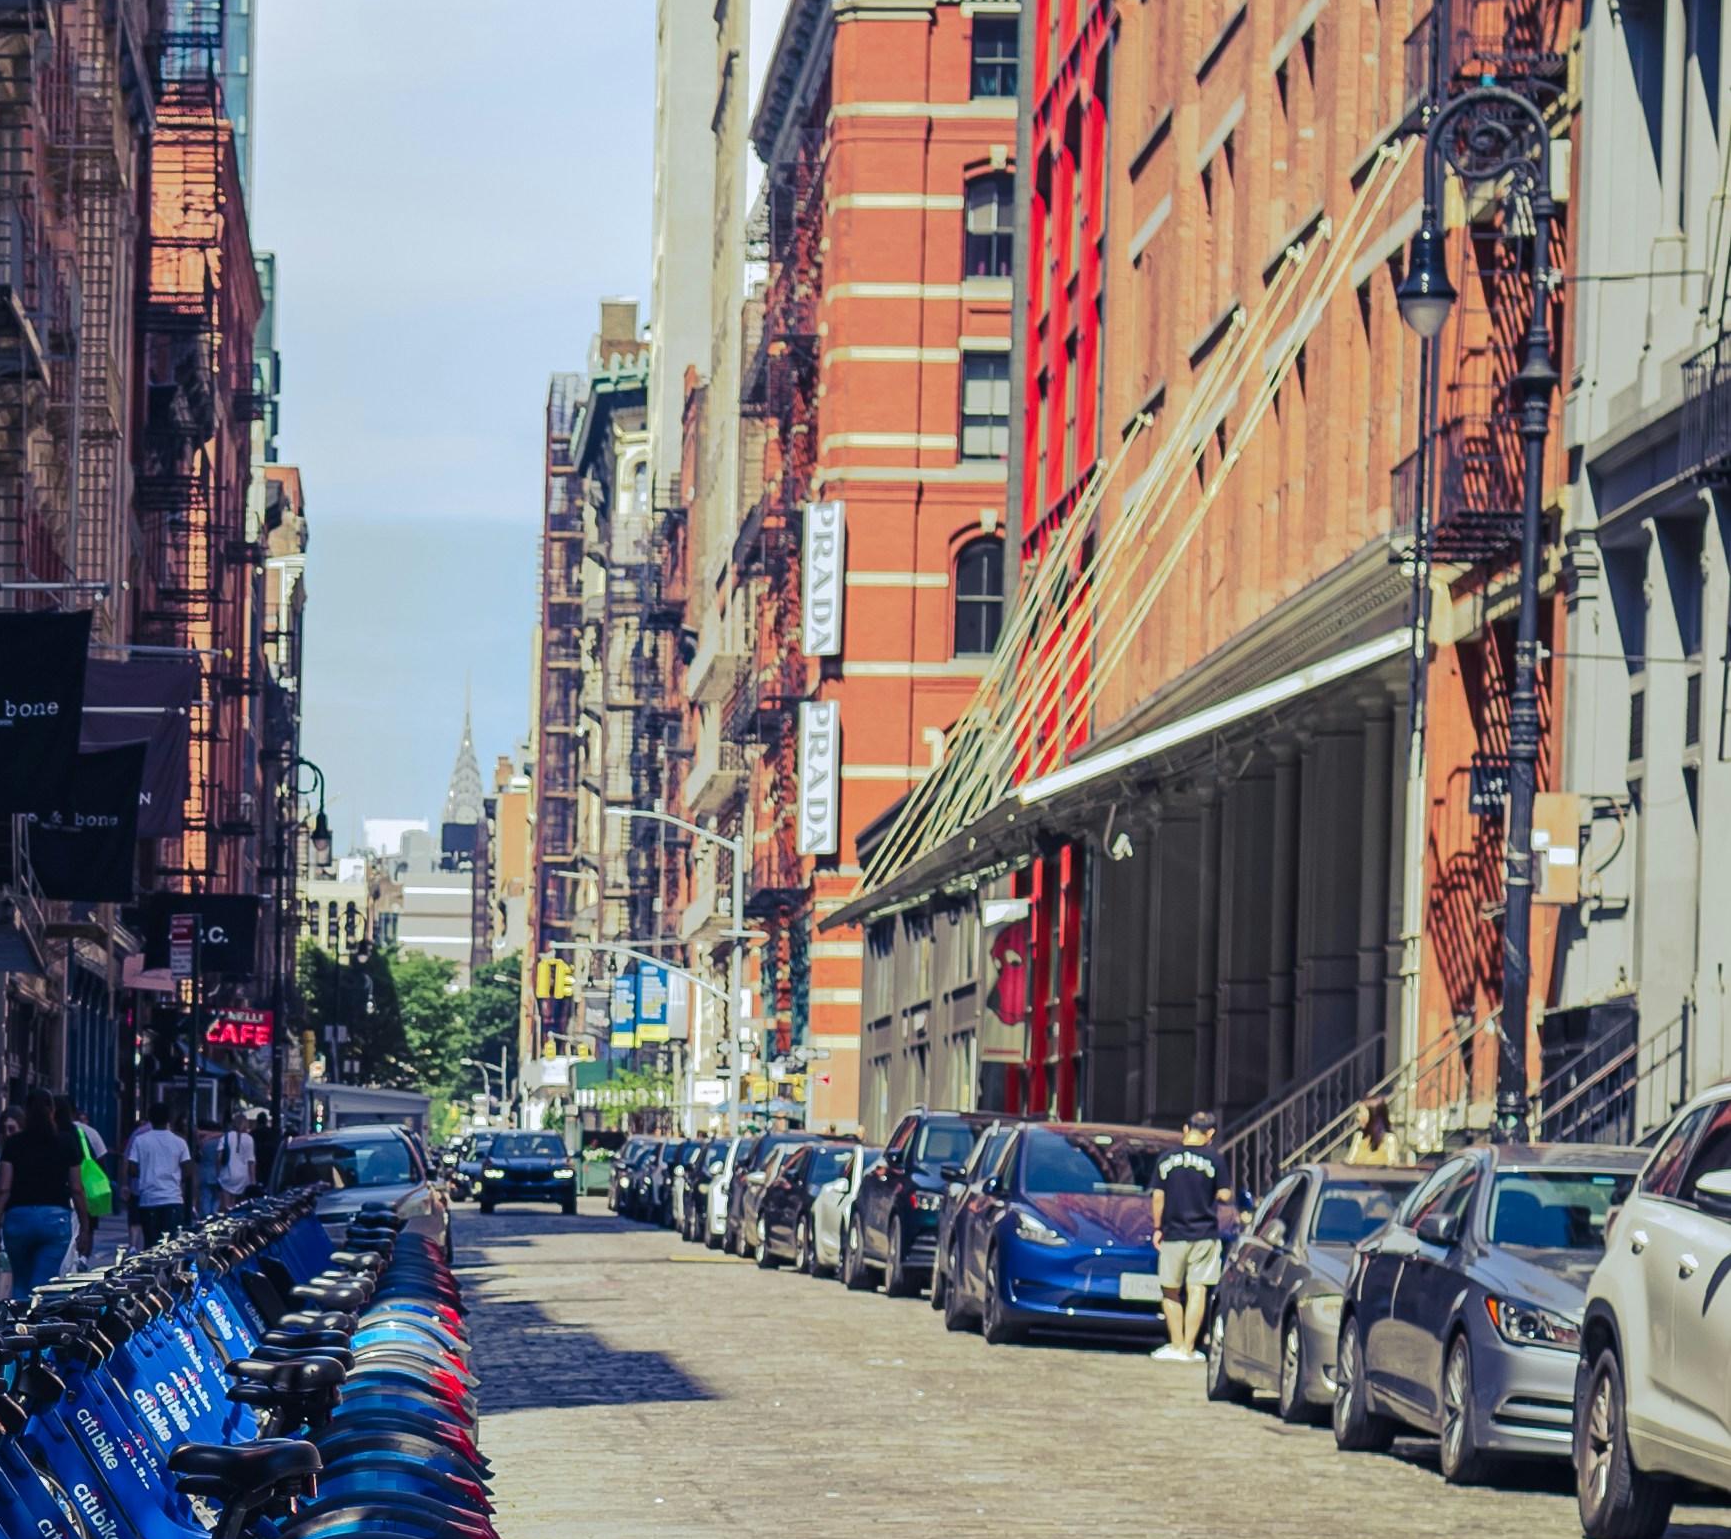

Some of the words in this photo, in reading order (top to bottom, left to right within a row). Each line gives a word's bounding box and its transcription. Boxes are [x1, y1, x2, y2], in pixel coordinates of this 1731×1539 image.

[811, 503, 835, 653] PRADA
[5, 698, 60, 719] bone
[805, 704, 830, 851] PRADA
[206, 1023, 271, 1046] CAFE
